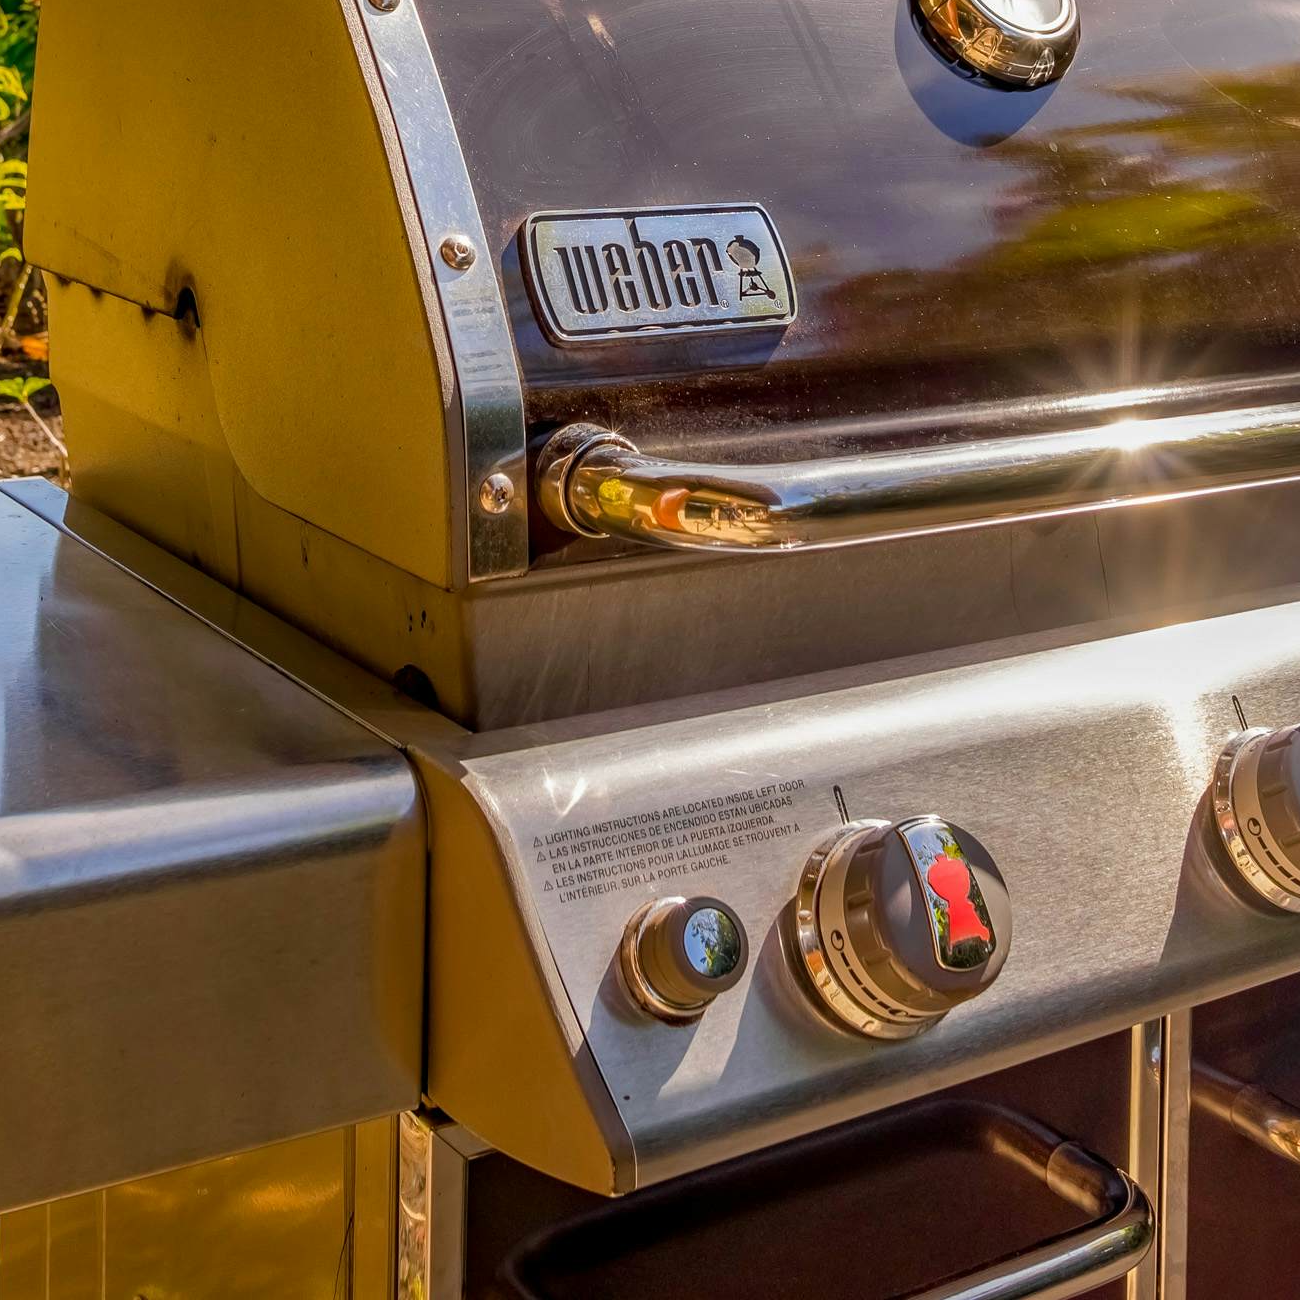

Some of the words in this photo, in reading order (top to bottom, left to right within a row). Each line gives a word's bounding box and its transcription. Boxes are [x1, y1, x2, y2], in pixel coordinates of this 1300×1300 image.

[553, 218, 723, 314] weber
[545, 826, 591, 845] LIGHTING
[592, 810, 661, 834] INSTRUCTIONS
[662, 805, 682, 819] ARE
[683, 797, 724, 814] LOCATED
[725, 789, 755, 805] INSIDE
[756, 784, 778, 799] LEFT
[779, 779, 805, 793] DOOR
[549, 845, 569, 859] LAS
[571, 828, 648, 854] INSTRUCCIONES
[648, 825, 662, 839] DE
[664, 813, 717, 834] ENCENDIDO
[749, 795, 793, 814] UBICADAS
[552, 860, 566, 875] EN
[568, 858, 582, 871] LA
[583, 850, 615, 868] PARTE
[615, 840, 661, 860] INTERIOR
[662, 837, 675, 849] DE
[676, 835, 690, 846] LA
[690, 825, 727, 843] PUERTA
[556, 875, 576, 889] LES
[576, 858, 648, 885] INSTRUCTIONS
[648, 851, 675, 866] POUR
[732, 835, 746, 848] SE
[745, 824, 793, 845] TROUVENT
[621, 875, 642, 890] SUR
[643, 871, 657, 884] LA
[657, 863, 689, 880] PORTE
